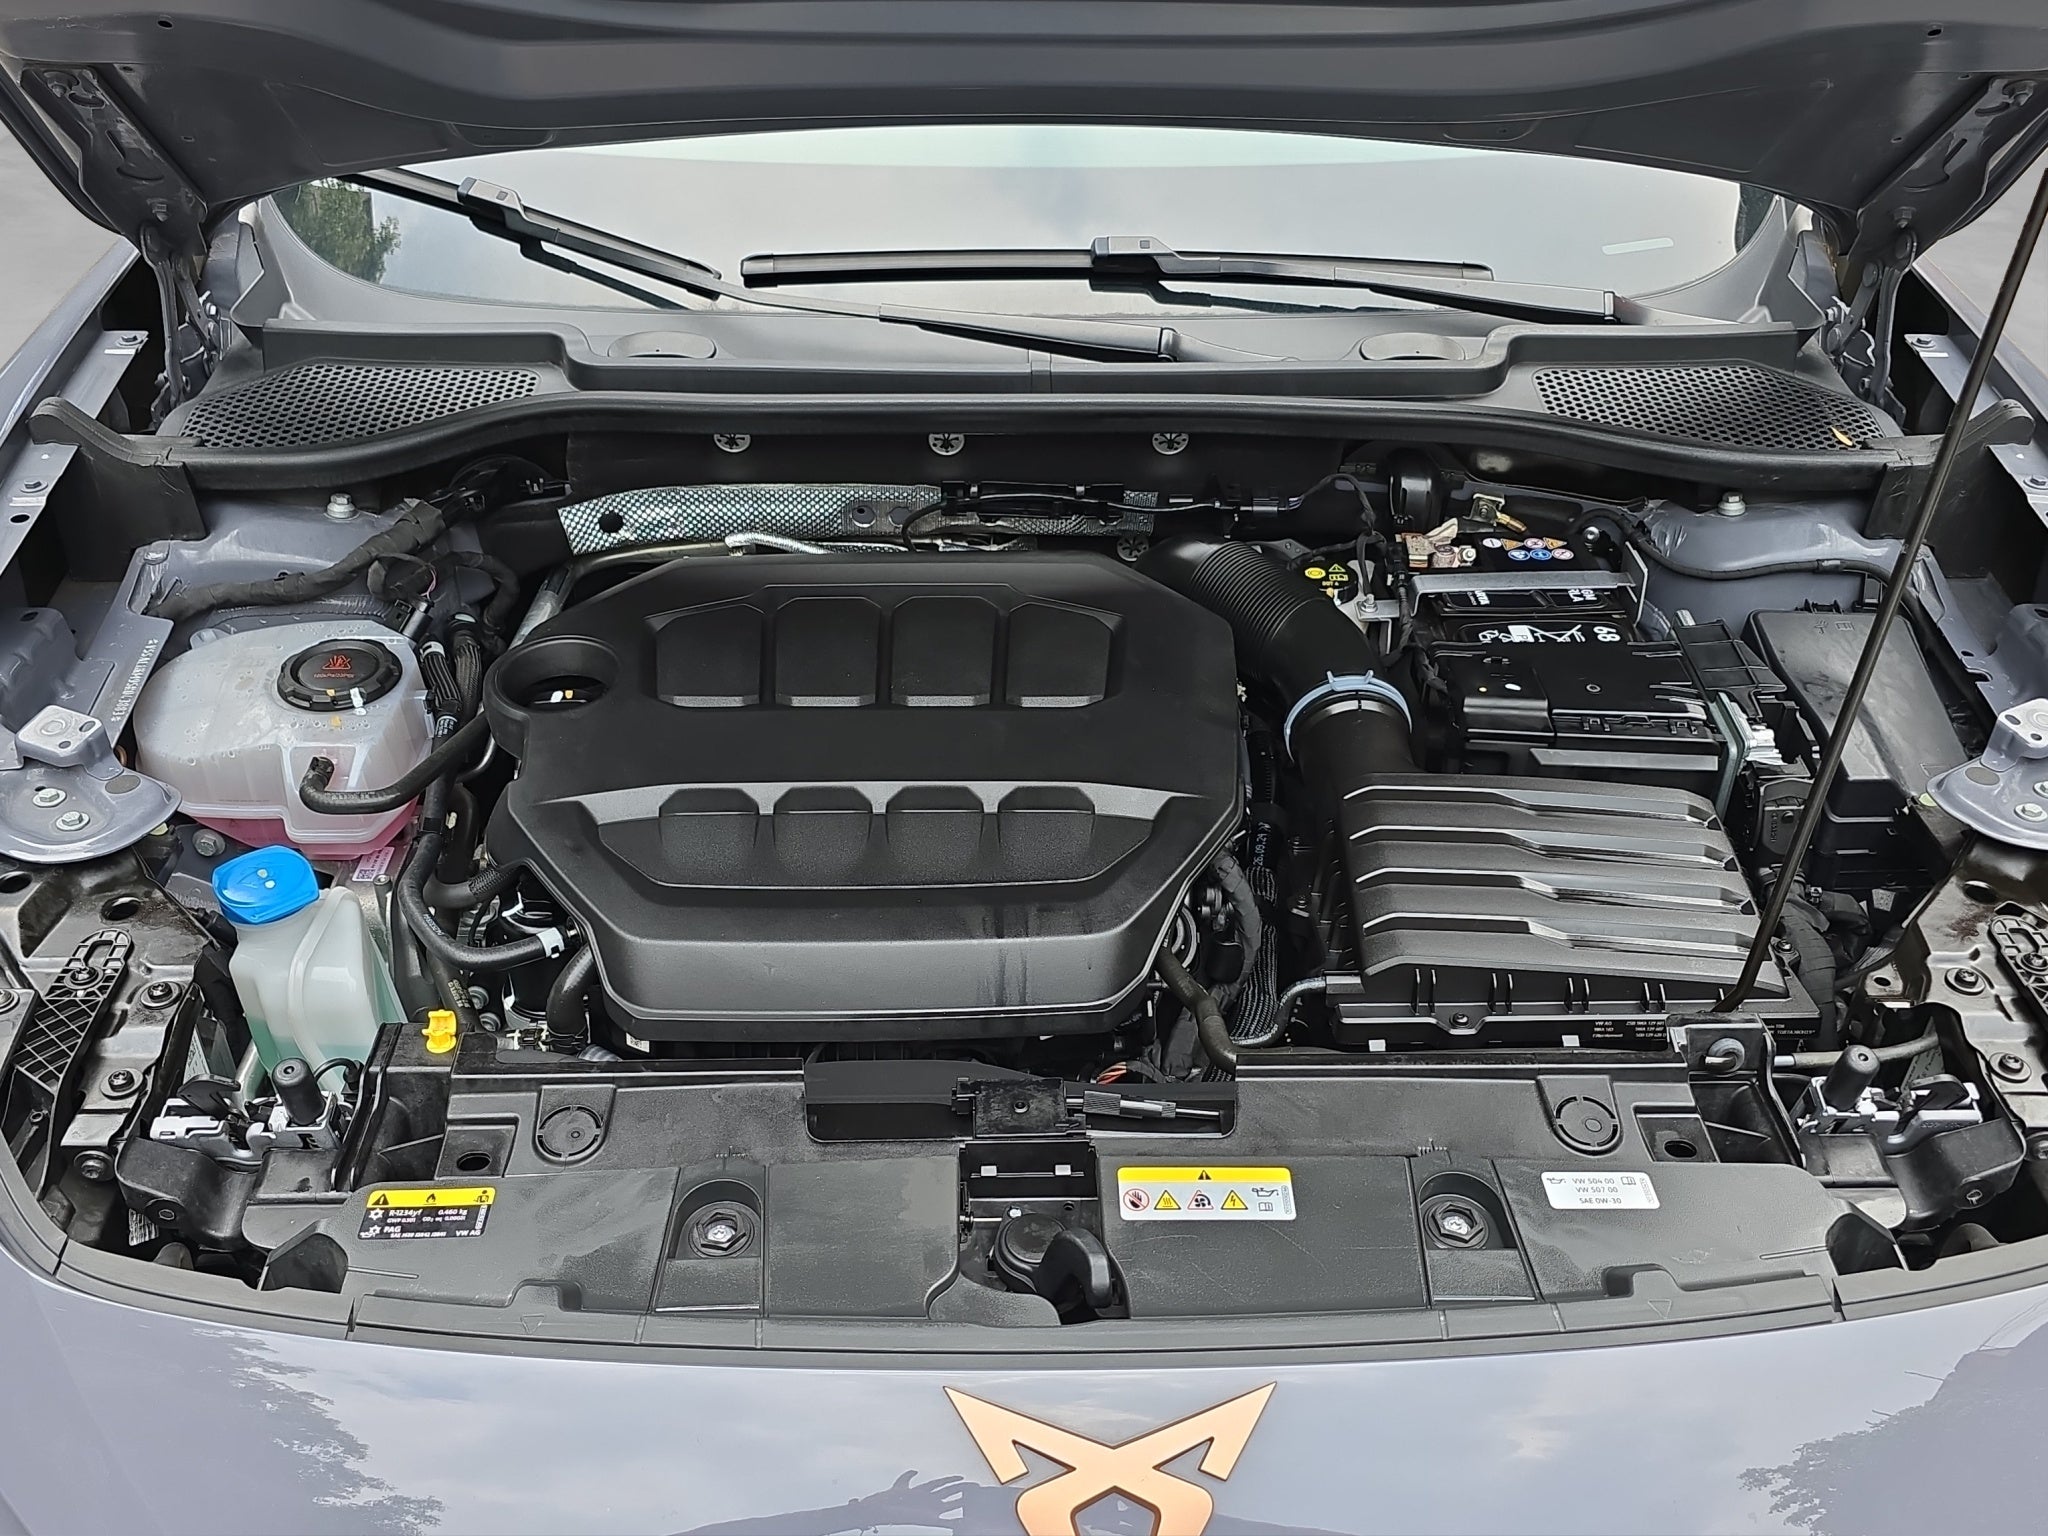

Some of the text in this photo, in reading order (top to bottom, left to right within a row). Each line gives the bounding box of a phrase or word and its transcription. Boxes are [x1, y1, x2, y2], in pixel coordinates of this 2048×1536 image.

[1568, 589, 1584, 602] RLA
[1581, 590, 1597, 600] GM
[1593, 626, 1620, 641] 68
